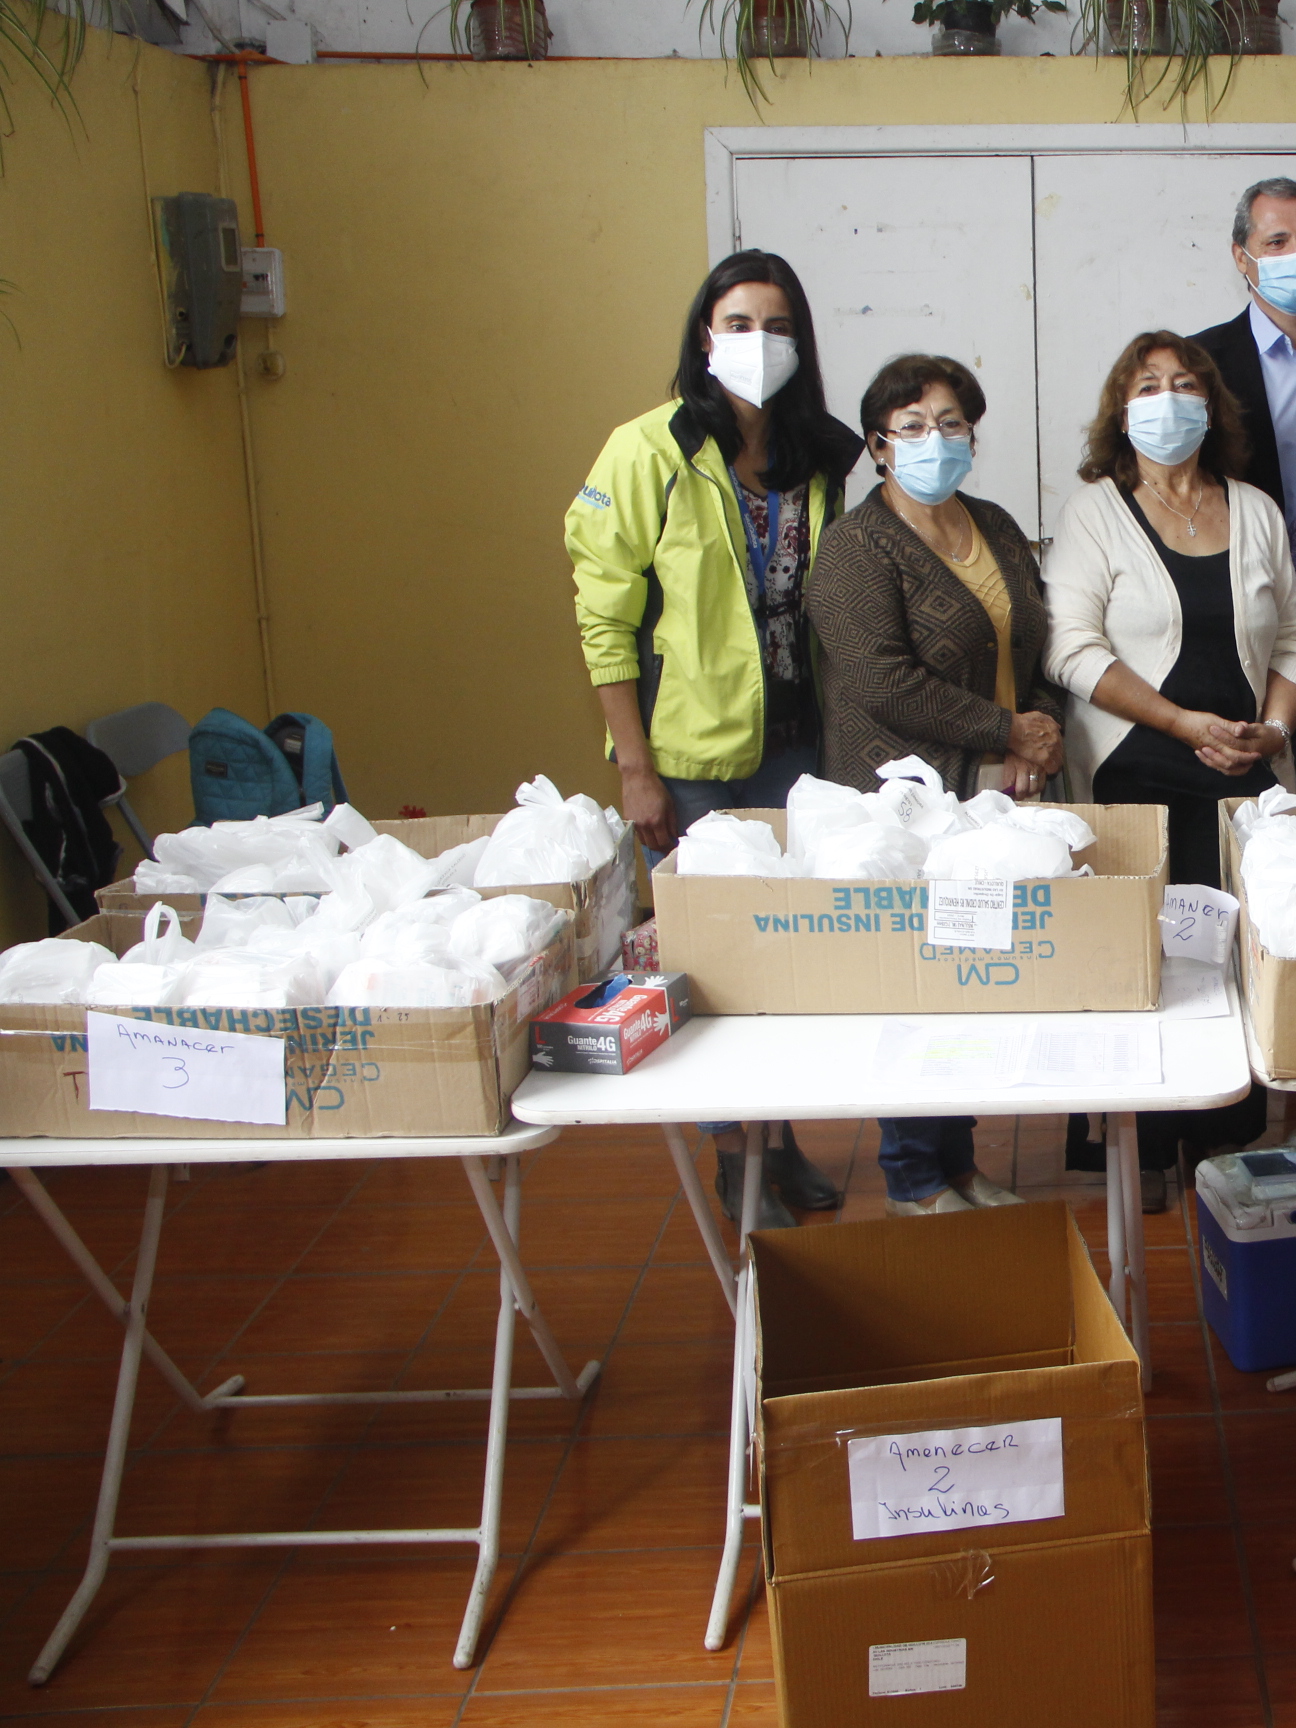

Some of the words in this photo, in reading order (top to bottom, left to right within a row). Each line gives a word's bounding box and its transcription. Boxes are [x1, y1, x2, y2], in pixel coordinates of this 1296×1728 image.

[753, 913, 882, 933] INSULINA
[891, 912, 924, 932] DE
[1173, 917, 1196, 941] 2
[535, 1026, 547, 1044] L
[567, 1035, 597, 1046] Guante
[597, 1037, 616, 1052] 4G
[162, 1056, 190, 1089] 3
[928, 1465, 955, 1493] 2
